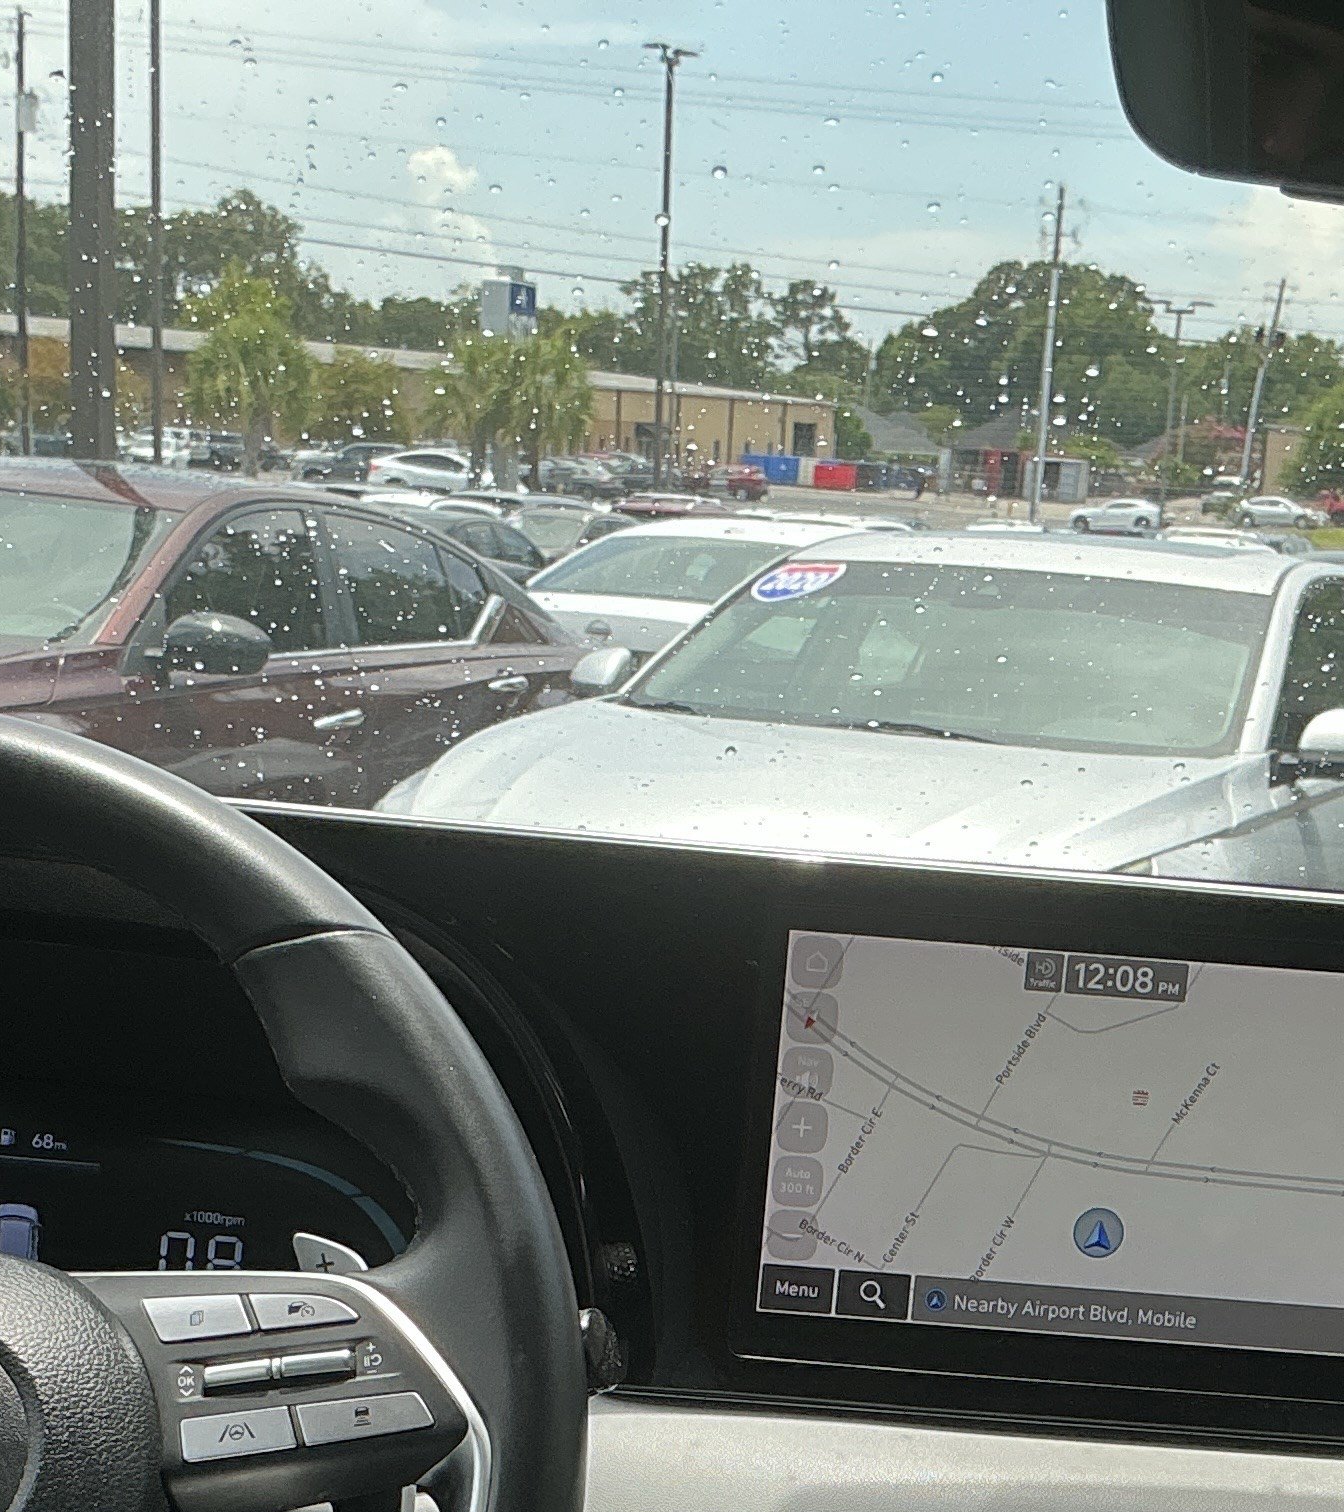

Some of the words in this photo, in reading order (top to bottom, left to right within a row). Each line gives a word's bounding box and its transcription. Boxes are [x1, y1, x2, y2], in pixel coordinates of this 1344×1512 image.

[1074, 962, 1155, 994] 12:08
[1157, 981, 1180, 996] PM
[995, 1038, 1031, 1085] Portside
[1024, 1012, 1047, 1040] Blvd
[806, 1084, 824, 1102] Rd
[1171, 1074, 1210, 1126] McKenna
[1205, 1061, 1221, 1078] Ct
[837, 1134, 866, 1175] Border
[861, 1119, 876, 1137] Cir
[872, 1106, 884, 1119] E
[780, 1182, 801, 1195] 300
[785, 1167, 811, 1180] Auto
[183, 1210, 246, 1228] x1000rpm
[993, 1229, 1008, 1247] Cir
[1002, 1215, 1015, 1229] W
[798, 1217, 836, 1248] Border
[836, 1241, 854, 1257] Cir
[853, 1251, 866, 1264] N
[882, 1227, 910, 1264] Center
[905, 1210, 920, 1227] St
[775, 1280, 819, 1299] Menu
[953, 1294, 1019, 1319] Nearby
[1021, 1301, 1086, 1323] Airport
[1089, 1305, 1133, 1326] Blvd,
[1137, 1310, 1198, 1330] Mobile
[177, 1375, 196, 1387] OK
